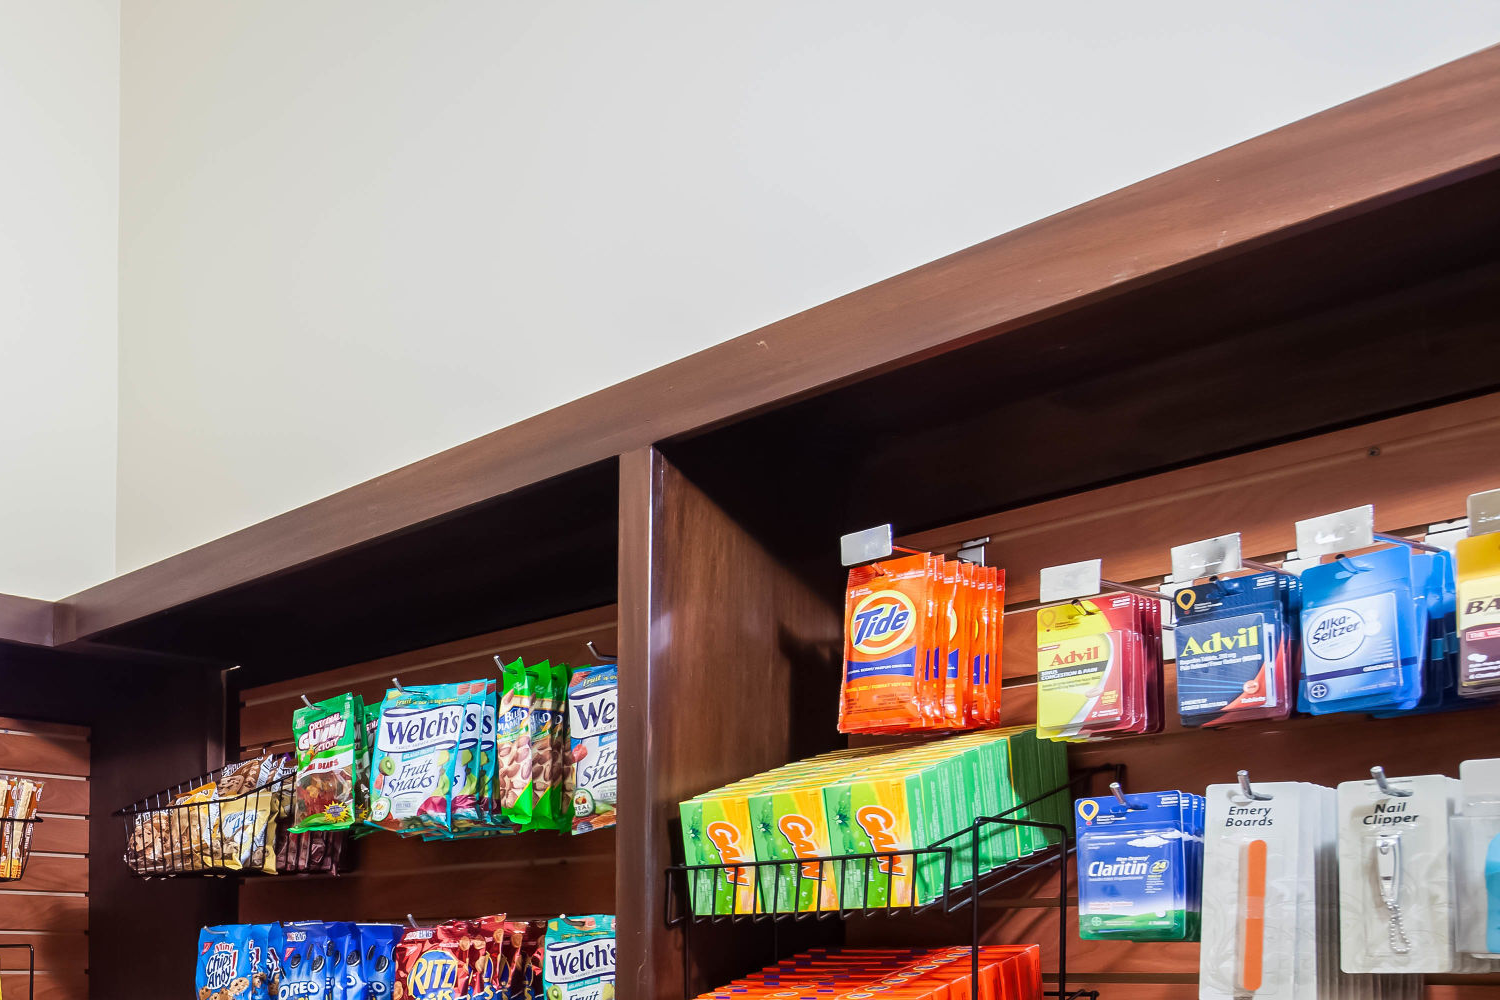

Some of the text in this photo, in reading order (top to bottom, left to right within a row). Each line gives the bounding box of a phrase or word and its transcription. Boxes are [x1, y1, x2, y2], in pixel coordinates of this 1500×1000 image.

[854, 604, 910, 647] Tide
[1312, 621, 1361, 645] Seltzer
[1315, 615, 1351, 634] Alka-
[1180, 625, 1259, 658] Advil
[1049, 645, 1101, 667] Advil
[386, 711, 460, 746] Welch's
[317, 759, 339, 771] BEARS
[400, 759, 433, 780] Fruit
[384, 773, 435, 797] Snacks
[1228, 805, 1271, 819] Emery
[1374, 801, 1407, 814] Nail
[1225, 816, 1274, 827] Boards
[1363, 812, 1420, 827] Clipper
[1088, 861, 1148, 877] Claritin
[214, 942, 235, 953] Mini
[206, 953, 233, 976] Chips
[551, 944, 616, 977] Welch's
[409, 957, 458, 999] RITZ
